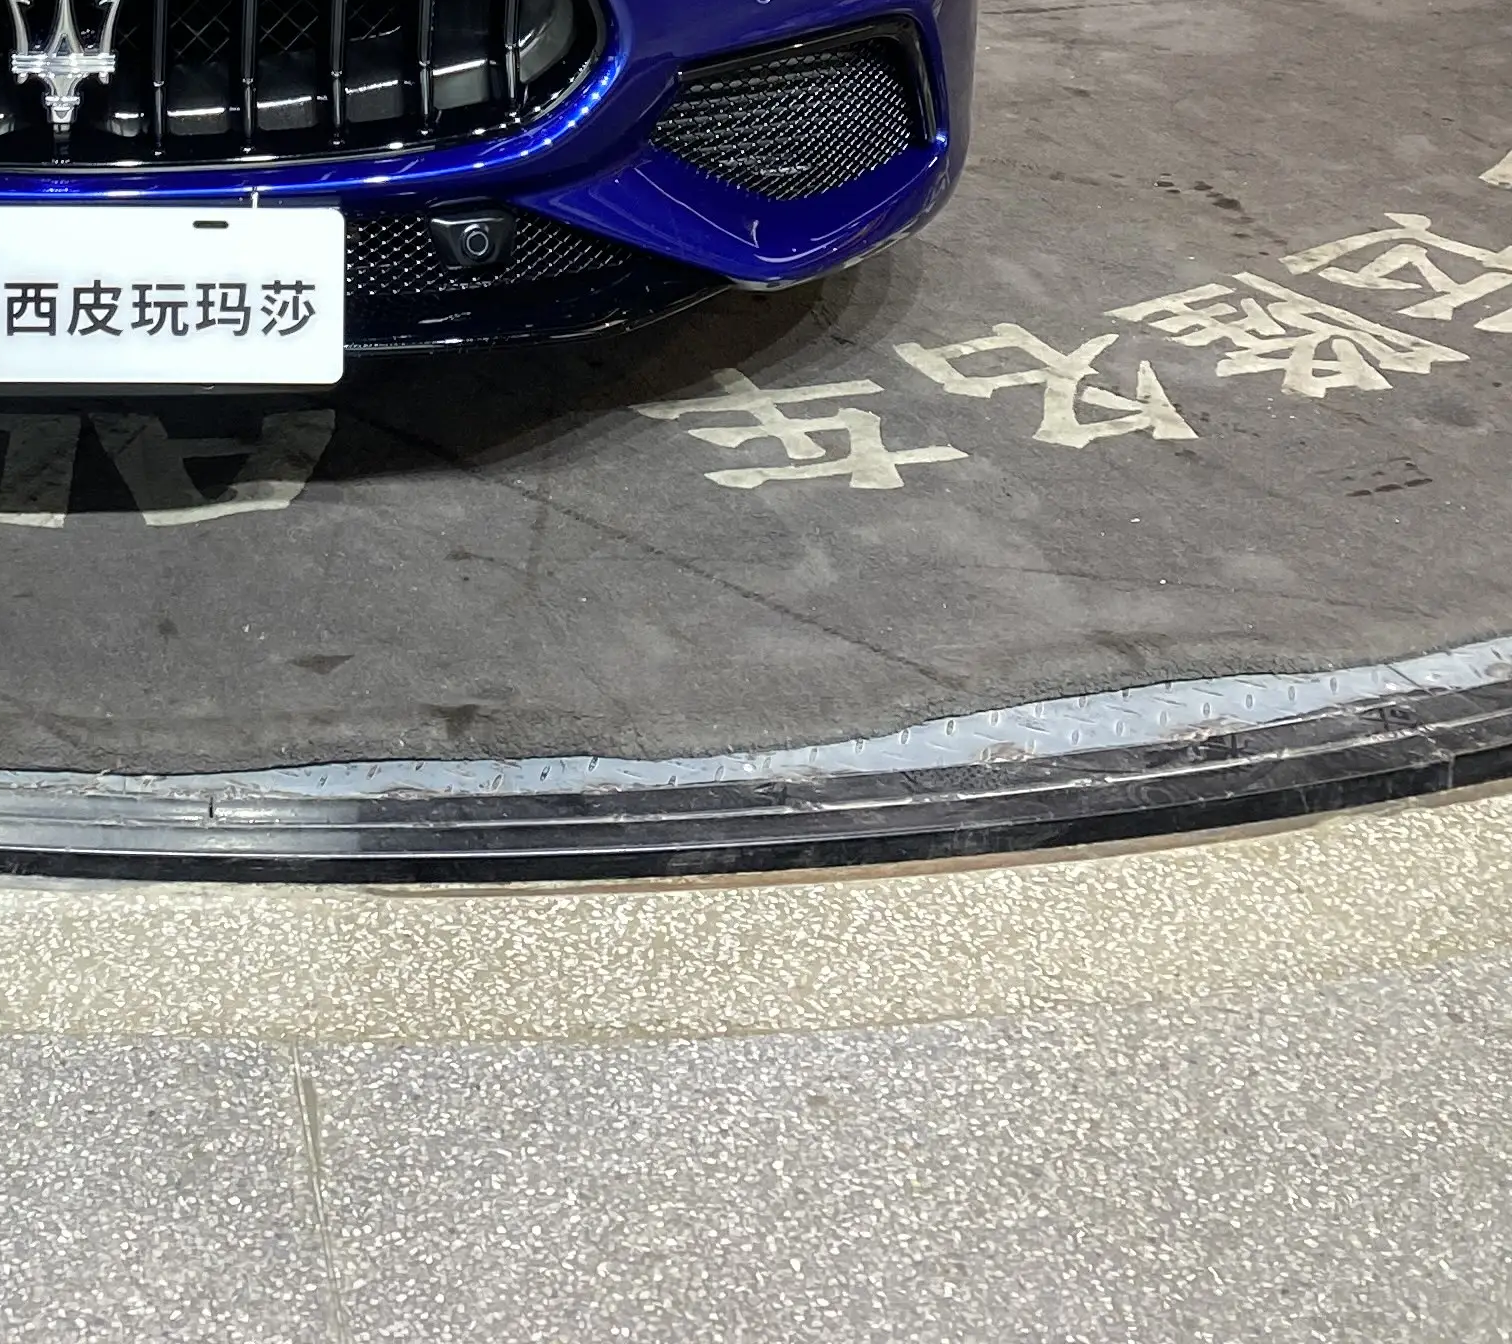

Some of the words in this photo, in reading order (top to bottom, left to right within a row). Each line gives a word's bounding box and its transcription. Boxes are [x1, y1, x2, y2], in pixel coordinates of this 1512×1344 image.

[4, 279, 316, 336] 西皮玩玛莎
